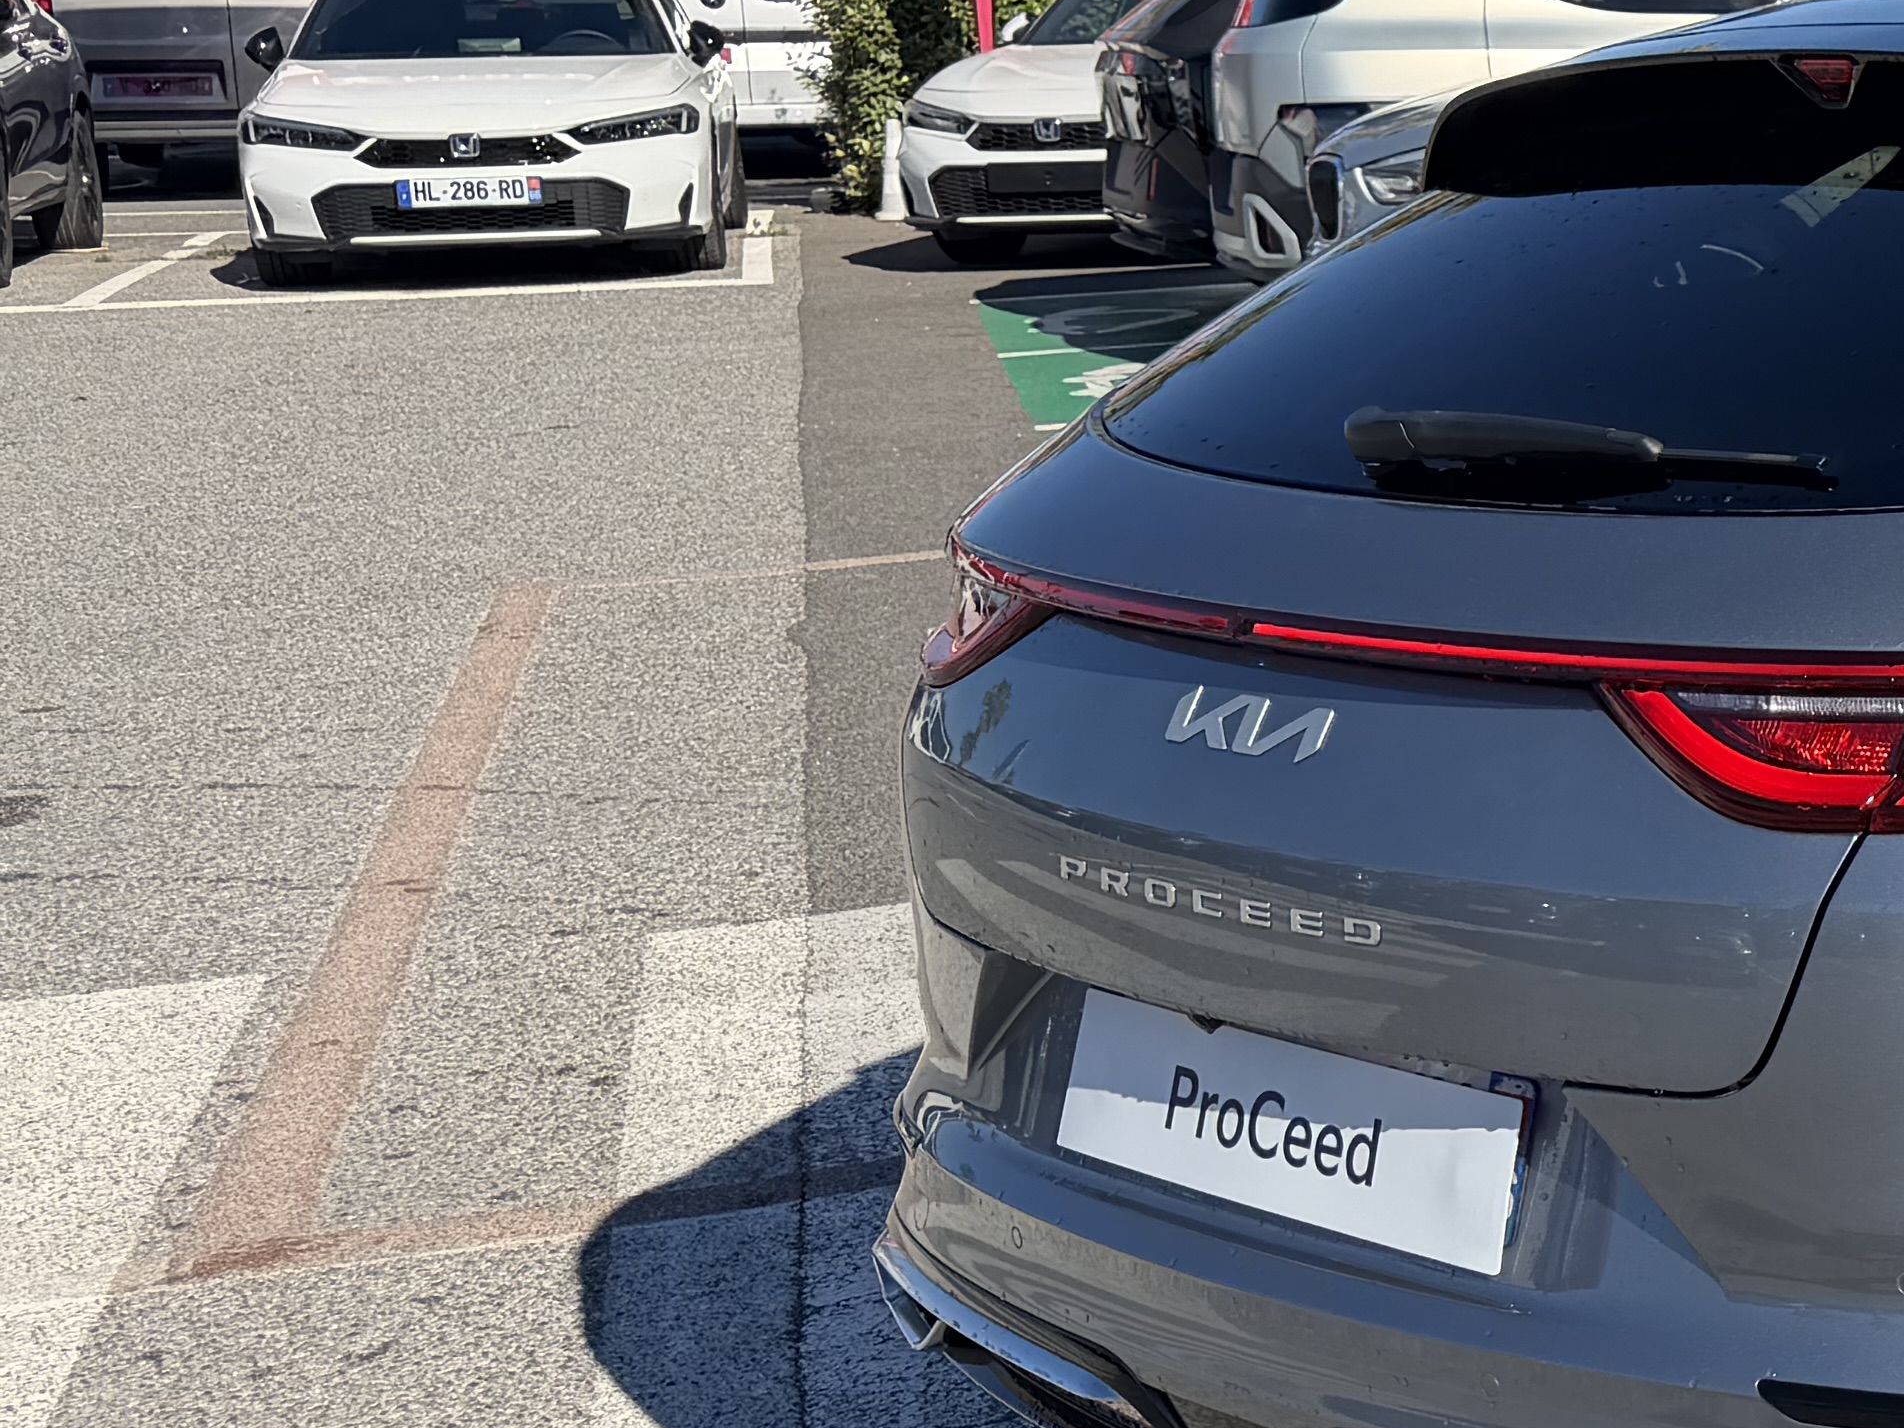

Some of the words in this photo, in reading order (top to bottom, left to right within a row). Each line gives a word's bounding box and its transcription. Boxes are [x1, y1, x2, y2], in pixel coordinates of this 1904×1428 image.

[413, 179, 525, 202] HL-286-RD
[1165, 685, 1337, 763] KIA
[1060, 855, 1383, 947] PROCEED
[1164, 1064, 1383, 1187] ProCeed
